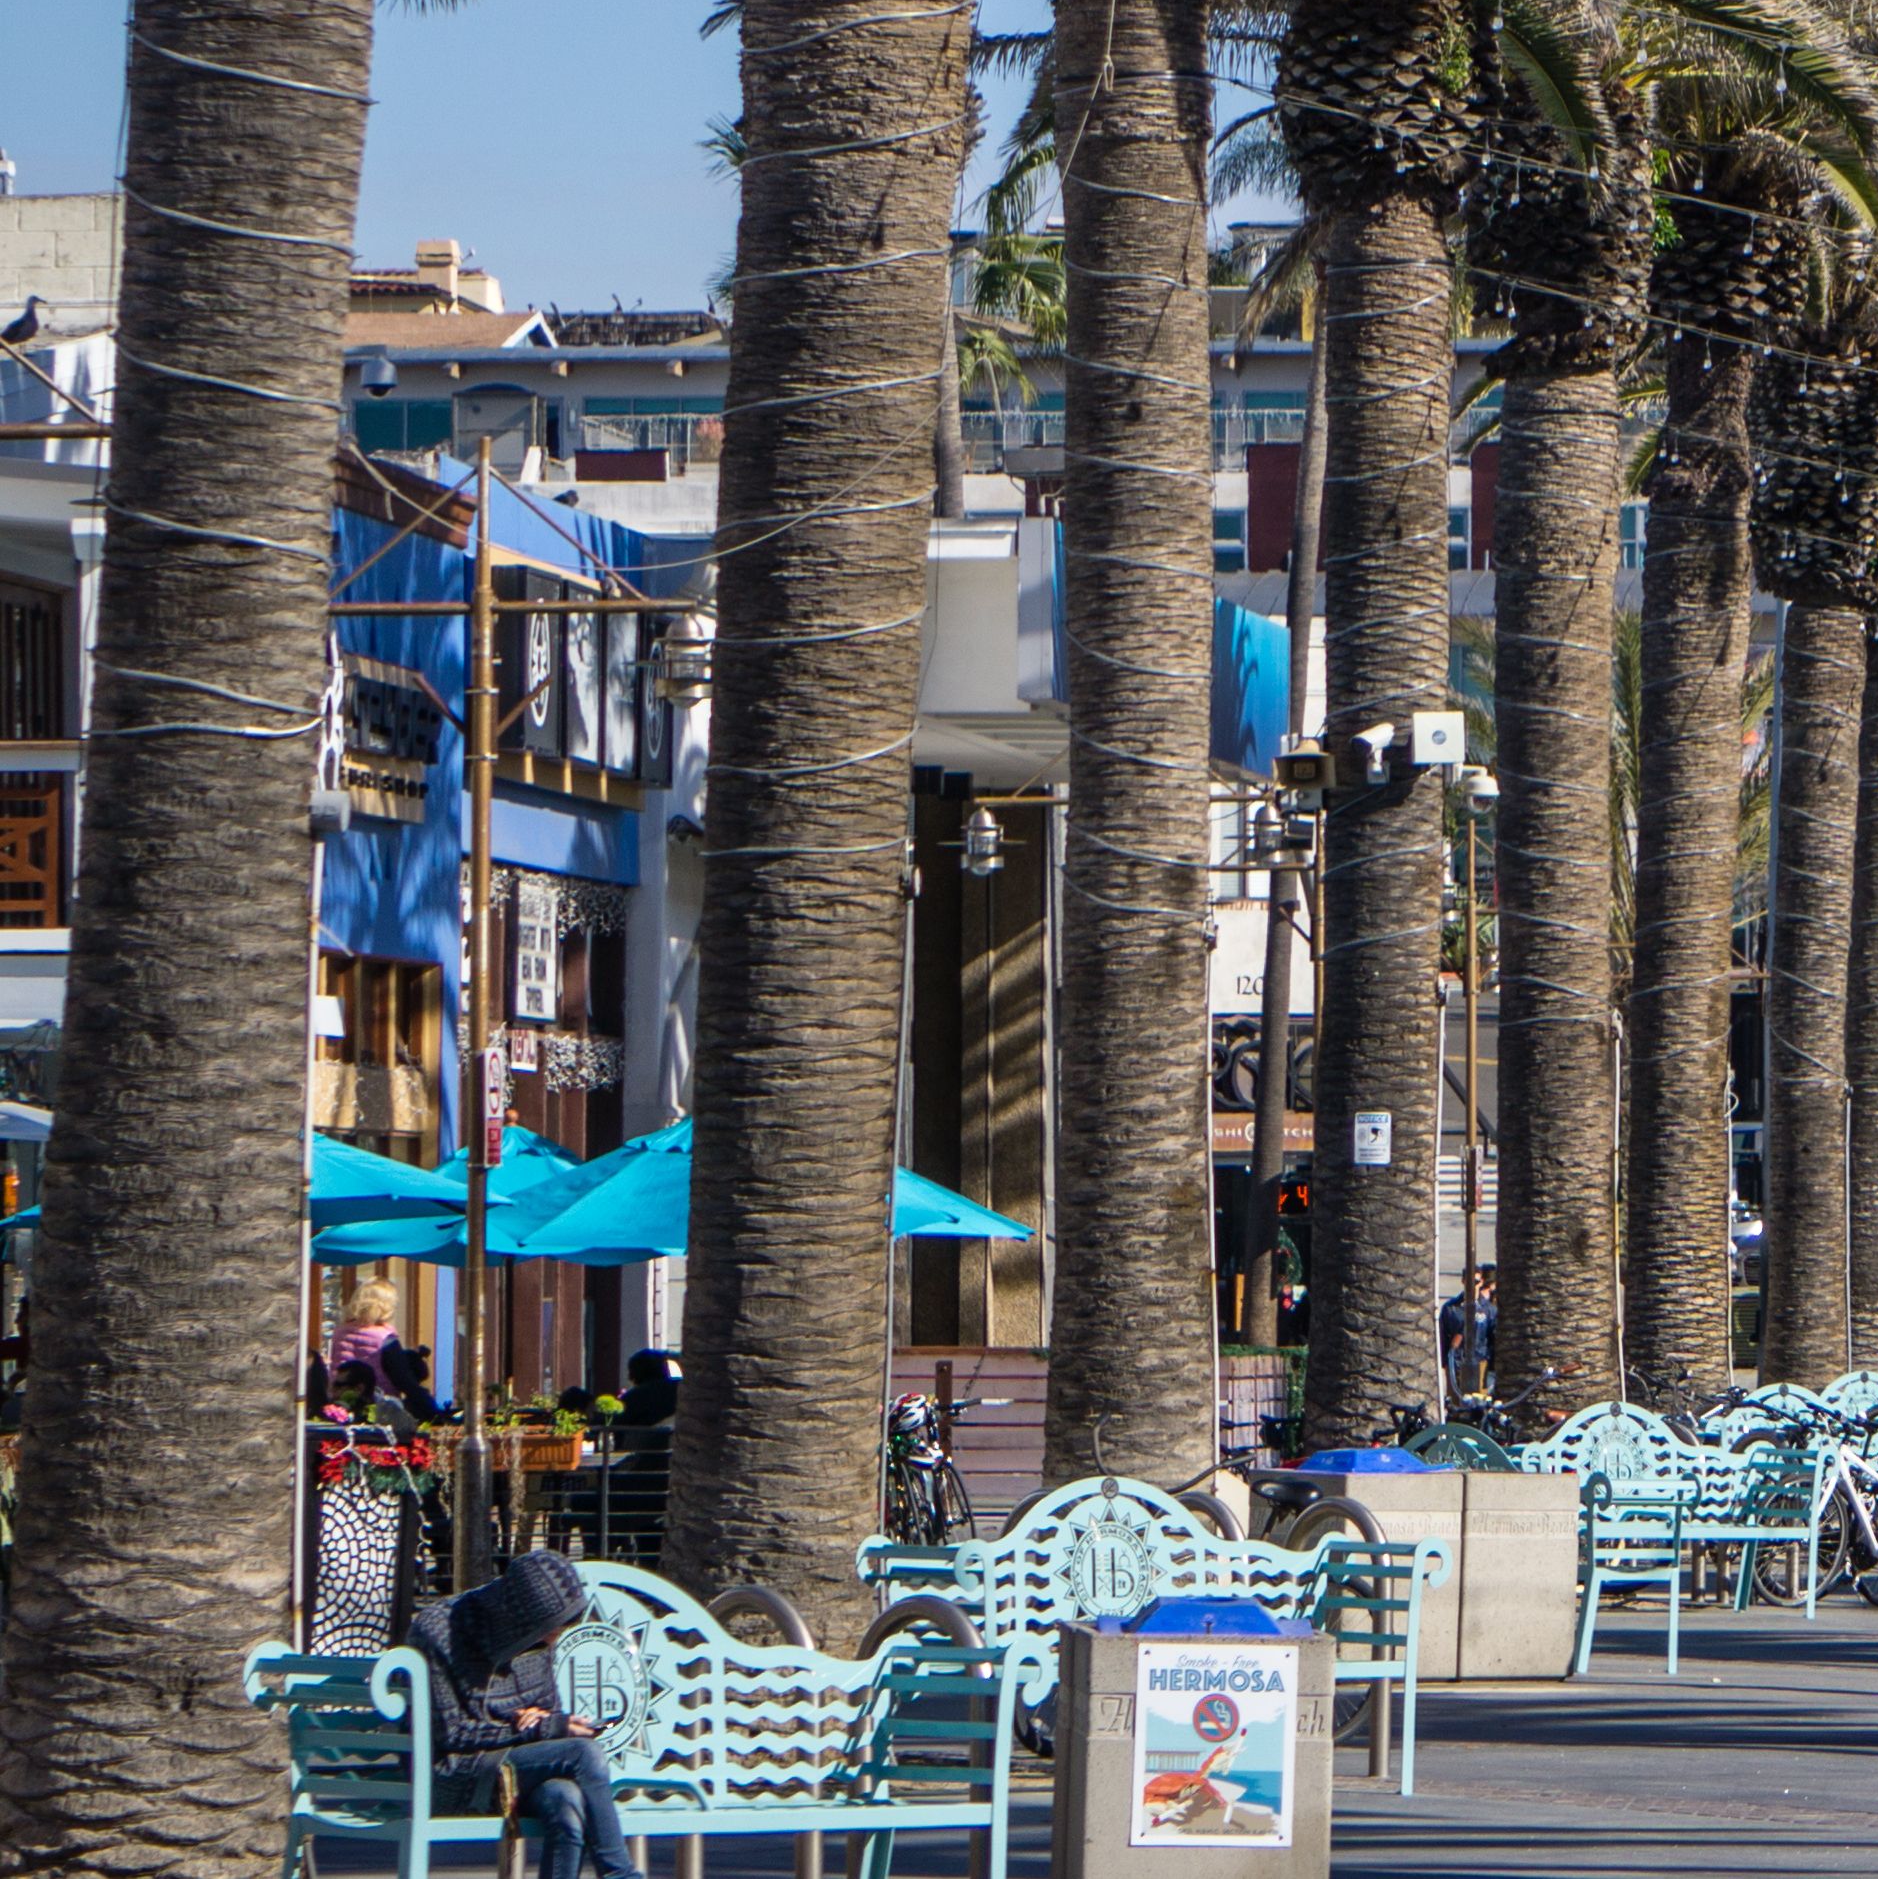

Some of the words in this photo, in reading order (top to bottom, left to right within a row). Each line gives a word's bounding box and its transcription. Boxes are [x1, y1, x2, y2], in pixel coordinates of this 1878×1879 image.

[1213, 1127, 1243, 1138] SHI
[1175, 1654, 1218, 1668] Smoke
[1148, 1668, 1286, 1693] HERMOSA
